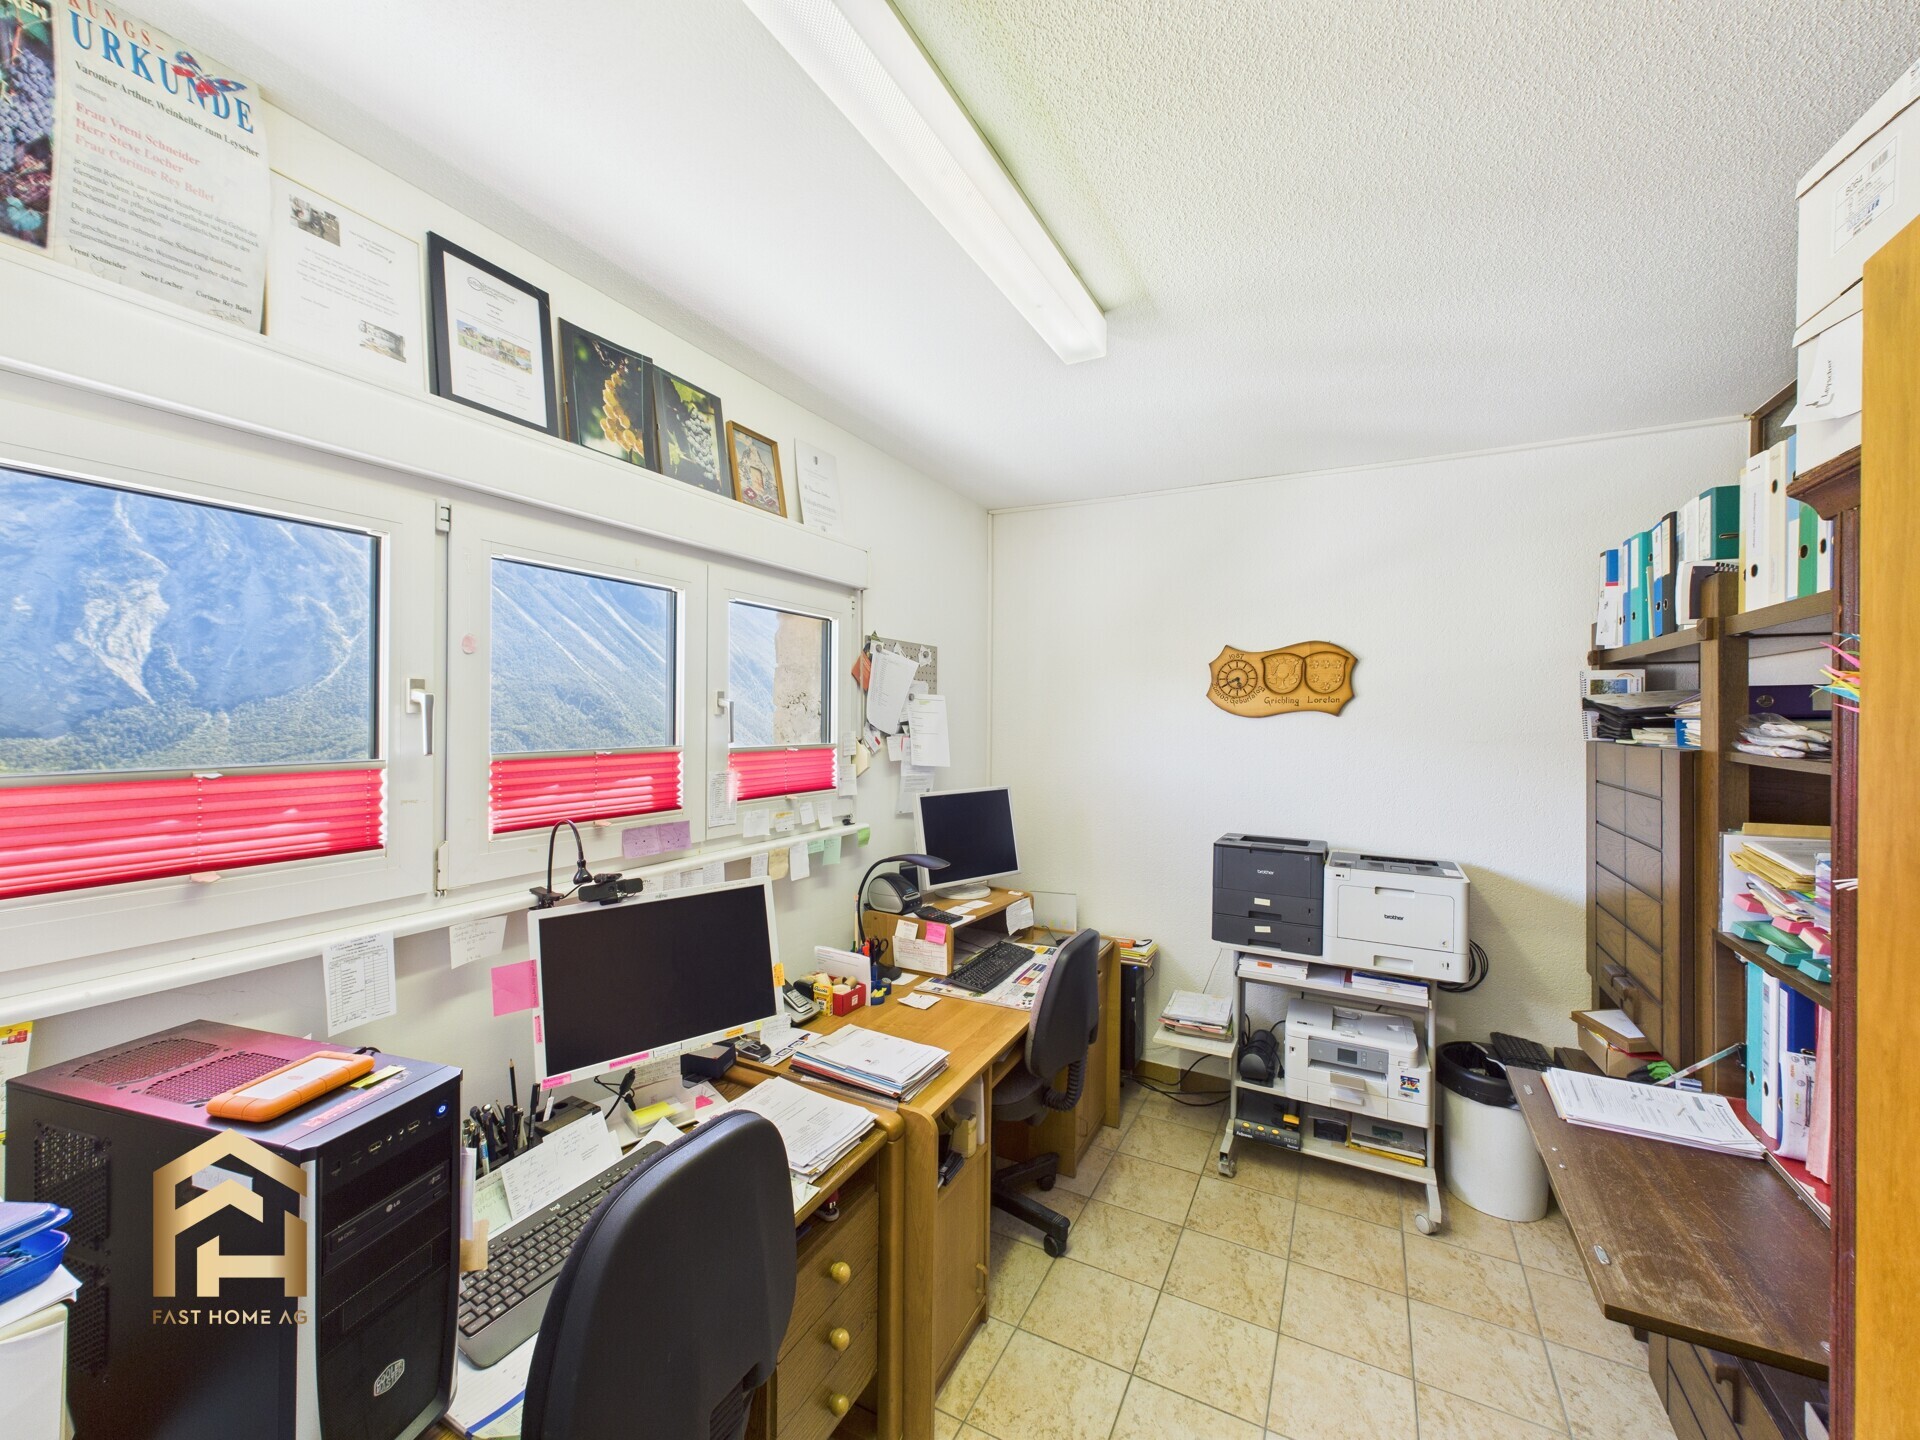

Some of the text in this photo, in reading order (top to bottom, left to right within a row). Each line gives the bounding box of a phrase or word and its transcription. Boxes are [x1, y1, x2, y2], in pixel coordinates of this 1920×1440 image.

[67, 9, 254, 134] URKUNDE
[75, 60, 117, 89] Varonier
[119, 82, 154, 108] Arthur,
[156, 100, 202, 131] Weinkeller
[204, 127, 222, 141] zum
[75, 101, 200, 167] Frau Vreni Schneider
[75, 117, 183, 174] Herr Steve Locher
[75, 133, 214, 203] Frau Corinne Rey Bellet
[1263, 696, 1300, 707] Grichting
[549, 1203, 561, 1212] logi
